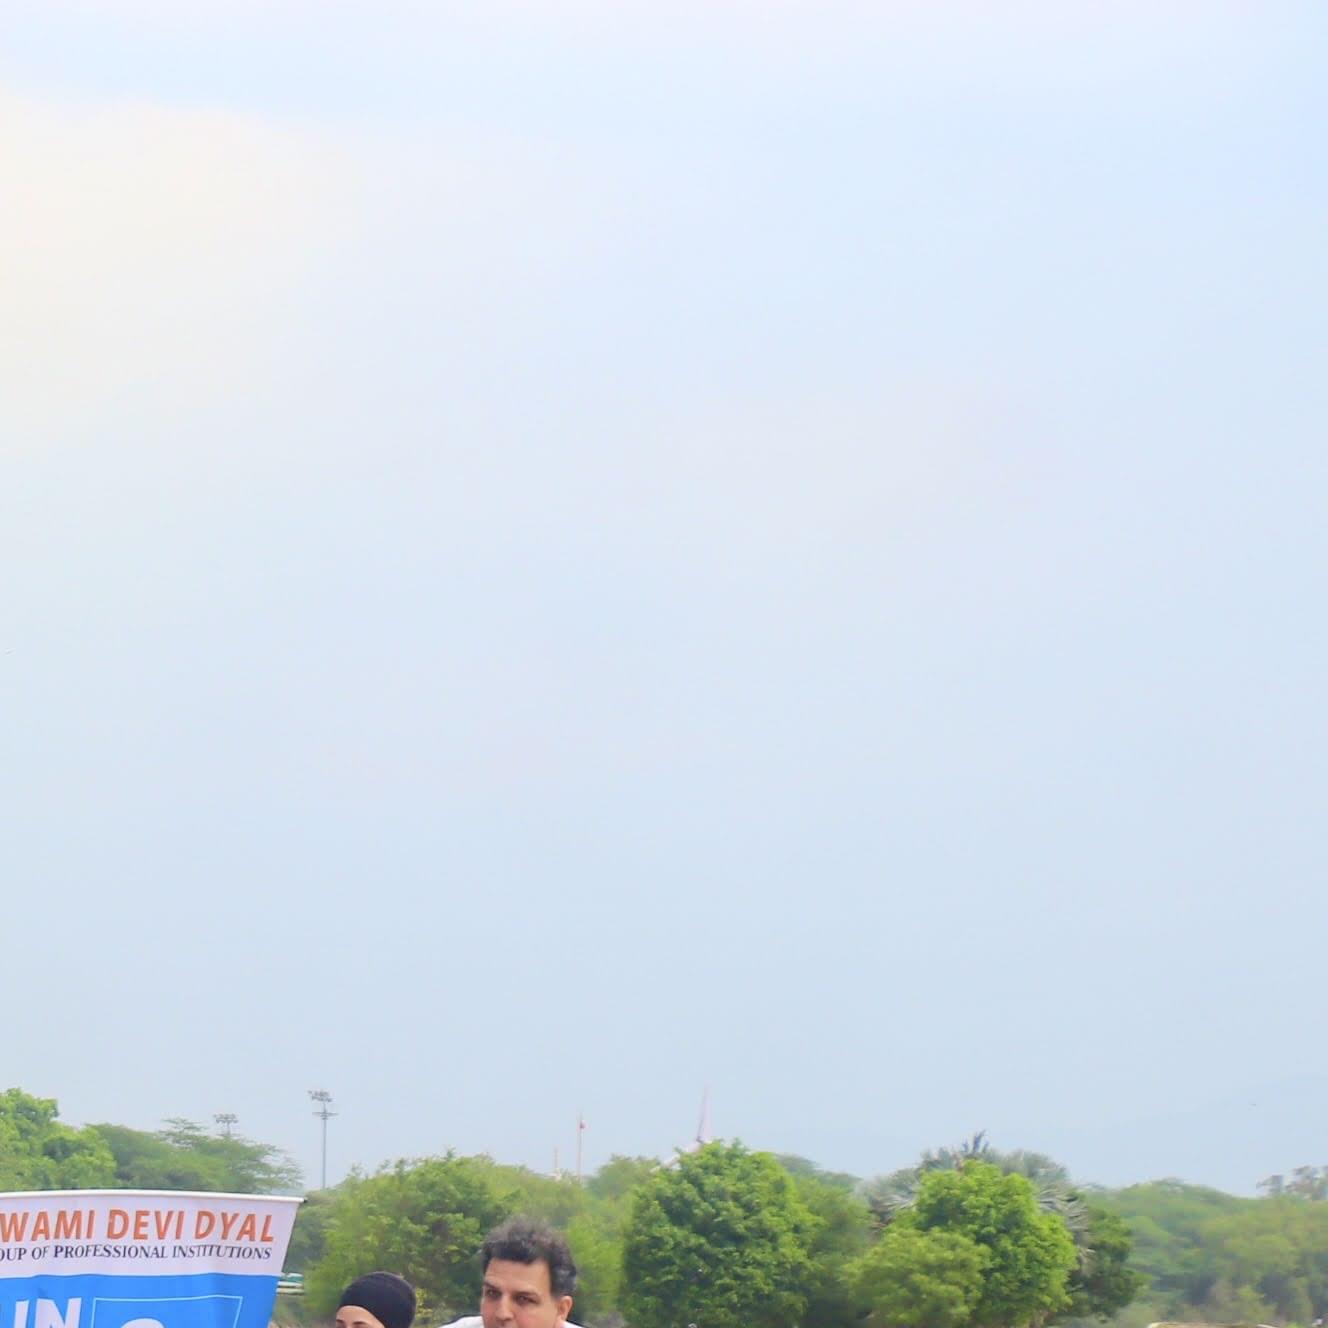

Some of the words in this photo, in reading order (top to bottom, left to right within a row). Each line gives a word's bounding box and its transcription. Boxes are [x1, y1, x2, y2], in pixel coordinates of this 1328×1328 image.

[107, 1209, 185, 1241] DEVI
[194, 1209, 274, 1243] DYAL
[31, 1245, 50, 1261] OF
[53, 1243, 168, 1260] PROFESSIONAL
[172, 1243, 273, 1260] INSTITUTIONS
